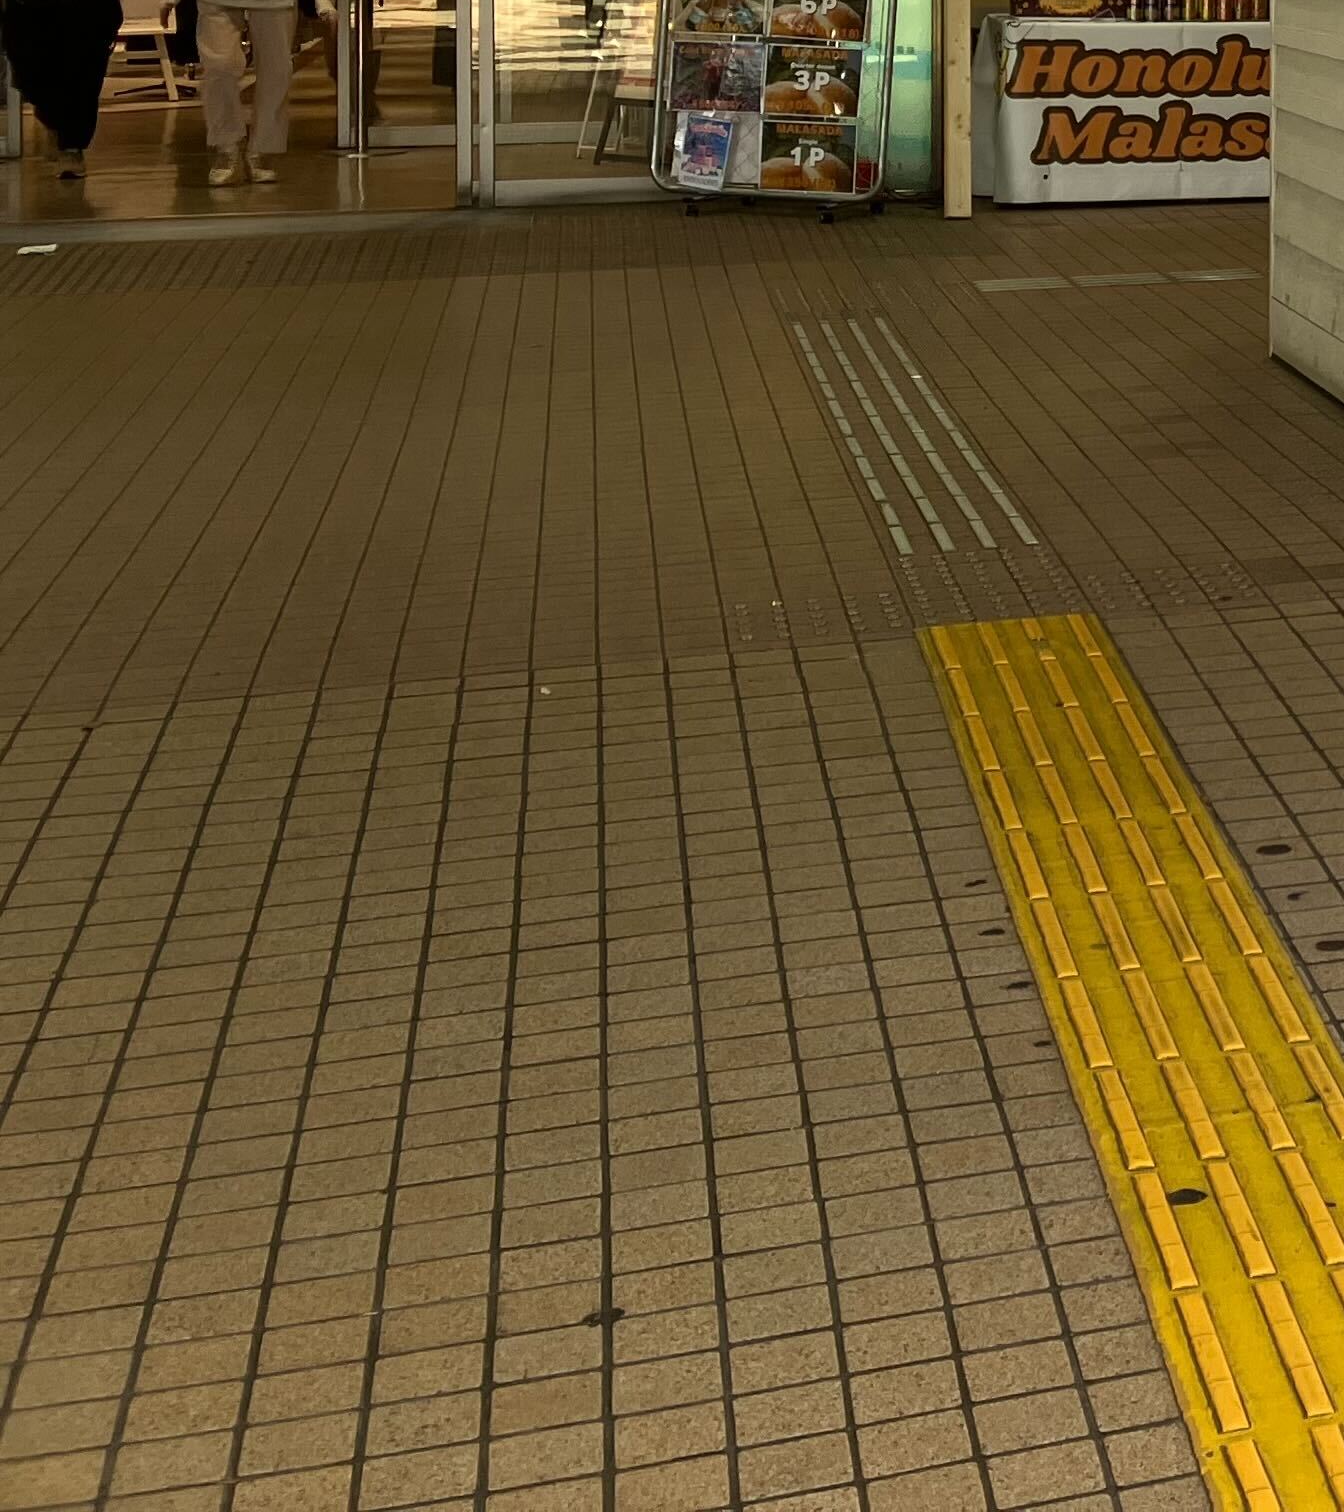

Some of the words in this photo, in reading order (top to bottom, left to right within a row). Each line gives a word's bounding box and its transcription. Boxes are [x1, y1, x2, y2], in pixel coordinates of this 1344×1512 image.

[793, 70, 830, 92] 3P
[1032, 101, 1270, 164] Malas
[790, 146, 825, 167] 1P
